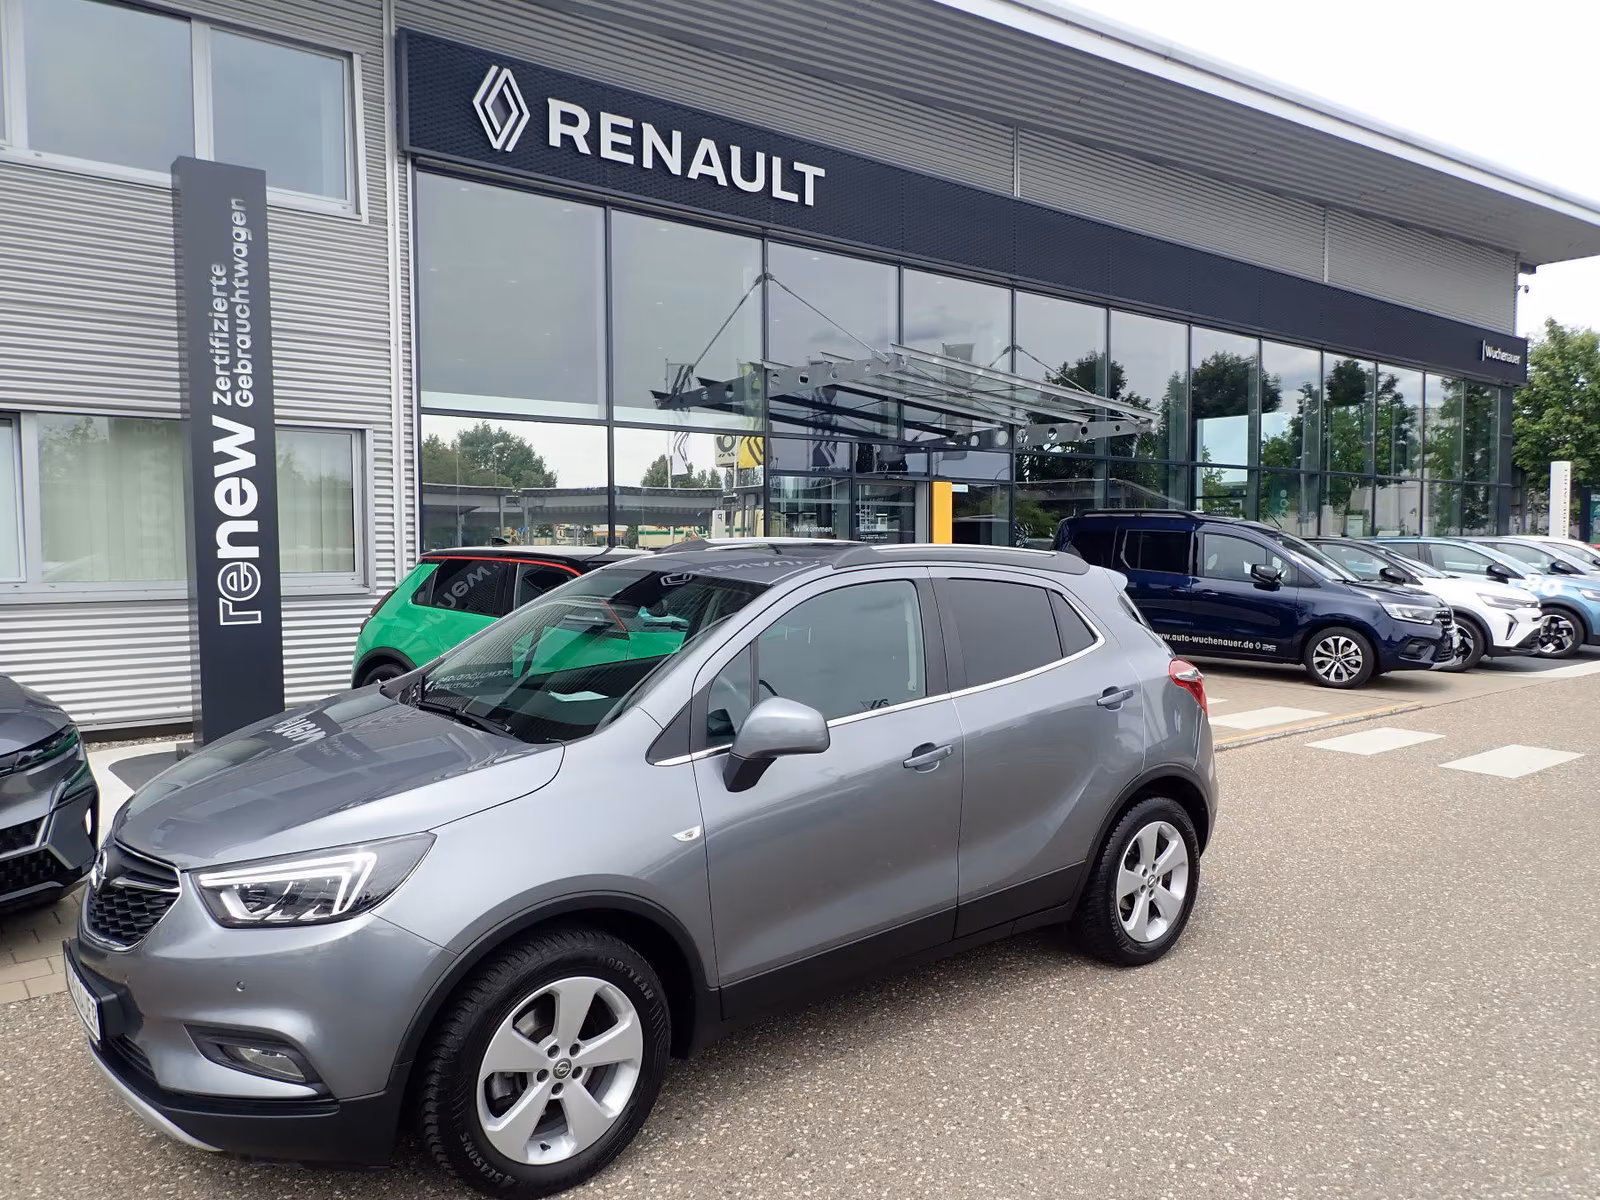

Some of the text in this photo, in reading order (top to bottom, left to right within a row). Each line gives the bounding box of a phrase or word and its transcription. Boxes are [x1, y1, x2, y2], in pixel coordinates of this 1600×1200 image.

[548, 97, 826, 207] RENAULT
[208, 262, 233, 406] Zertifizierte
[230, 198, 254, 408] Gebrauchtwagen
[212, 415, 262, 626] renew
[793, 523, 833, 533] Willkommen
[1155, 633, 1254, 649] ww.auto-wuchenauer.de
